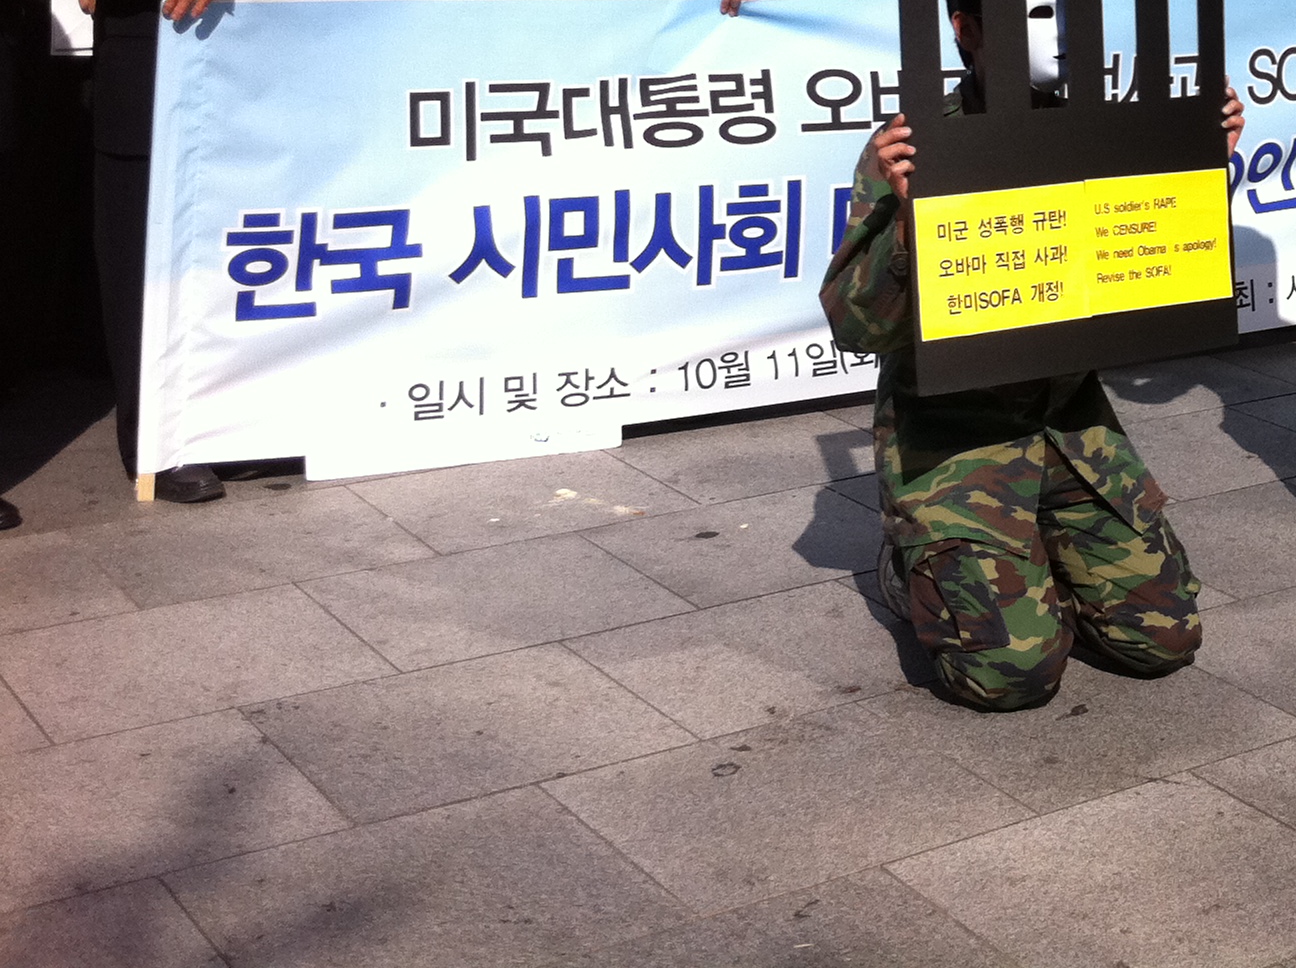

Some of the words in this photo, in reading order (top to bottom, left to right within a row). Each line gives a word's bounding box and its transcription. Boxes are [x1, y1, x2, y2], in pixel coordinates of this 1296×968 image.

[410, 69, 776, 161] 미국대통령
[1094, 202, 1111, 215] U.S
[1114, 200, 1151, 213] soldier's
[1153, 197, 1177, 210] RAPE
[937, 221, 969, 242] 미군
[978, 213, 1025, 239] 성폭행
[1032, 209, 1067, 232] 규탄!
[1095, 226, 1109, 238] We
[1113, 221, 1157, 237] CENSURE!
[226, 209, 423, 321] 한국
[448, 180, 802, 298] 시민사회
[938, 255, 987, 278] 오바마
[995, 249, 1027, 272] 직접
[1034, 244, 1068, 267] 사과!
[1096, 249, 1110, 261] We
[1113, 246, 1134, 259] need
[1137, 244, 1167, 258] Obama
[1182, 237, 1218, 254] apology!
[1096, 270, 1125, 285] Revise
[1128, 268, 1143, 282] the
[1145, 264, 1172, 280] SOFA!
[947, 287, 1022, 316] 한미SOFA
[1031, 281, 1064, 304] 개정!
[408, 376, 486, 421] 일시
[503, 373, 537, 413] 및
[555, 366, 631, 407] 장소
[677, 349, 752, 392] 10월
